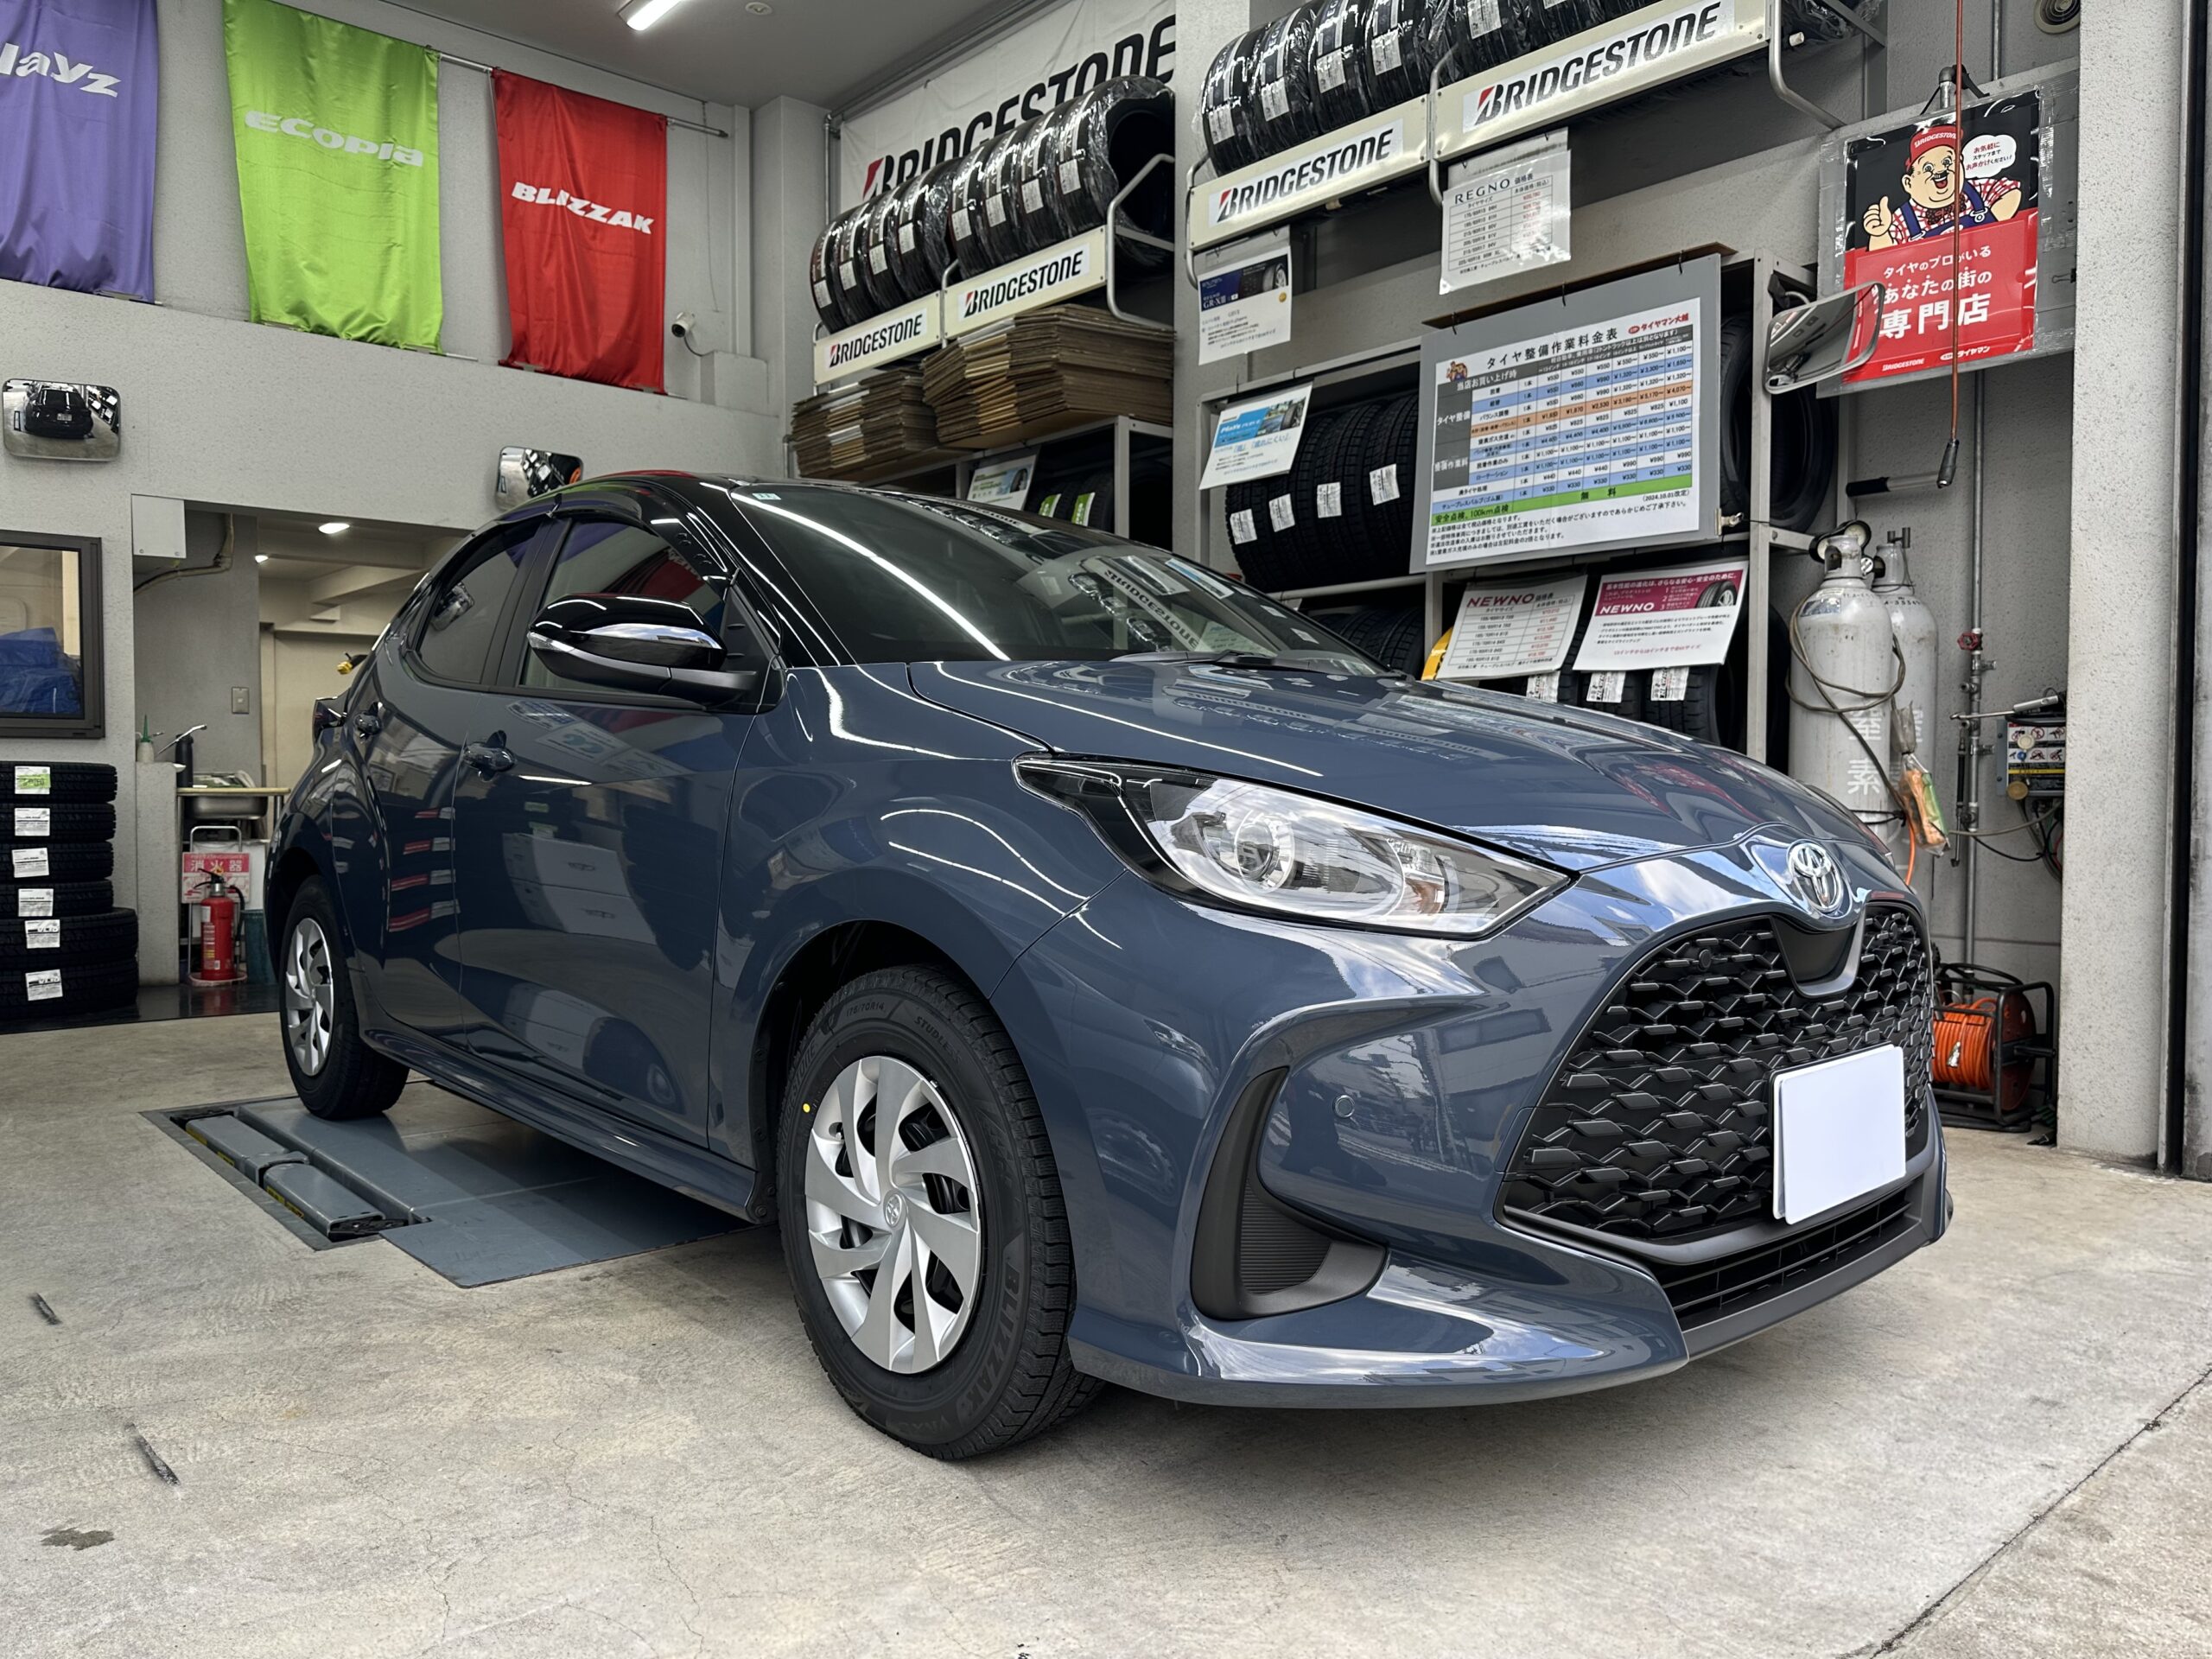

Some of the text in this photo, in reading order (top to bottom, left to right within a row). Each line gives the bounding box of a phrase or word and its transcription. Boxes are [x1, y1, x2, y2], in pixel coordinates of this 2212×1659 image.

[1473, 2, 1721, 125] BRIDGESTONE
[1914, 132, 1956, 148] BRIDGESTON
[1974, 142, 2000, 154] お気軽に
[1973, 149, 2001, 161] スタッフまで
[1217, 128, 1395, 223] BRIDGESTONE
[1454, 178, 1510, 205] REGNO
[511, 181, 655, 236] BLIZZAK
[963, 251, 1084, 318] BRIDGESTONE
[1884, 267, 1993, 305] あなたの街の
[1878, 293, 1991, 339] 専門店
[829, 313, 923, 368] BRIDGESTONE
[1486, 325, 1618, 370] タイヤ整備作業料金表
[1456, 367, 1517, 391] 当店お買い上げ時
[1669, 397, 1688, 407] ¥1,100
[1436, 410, 1471, 426] タイヤ整備
[1475, 469, 1508, 480] ローテーション
[1466, 594, 1535, 607] NEWNO
[1599, 601, 1655, 614] NEWNO
[845, 1001, 886, 1018] 175/70R14
[958, 1262, 1021, 1414] BLIZZAK
